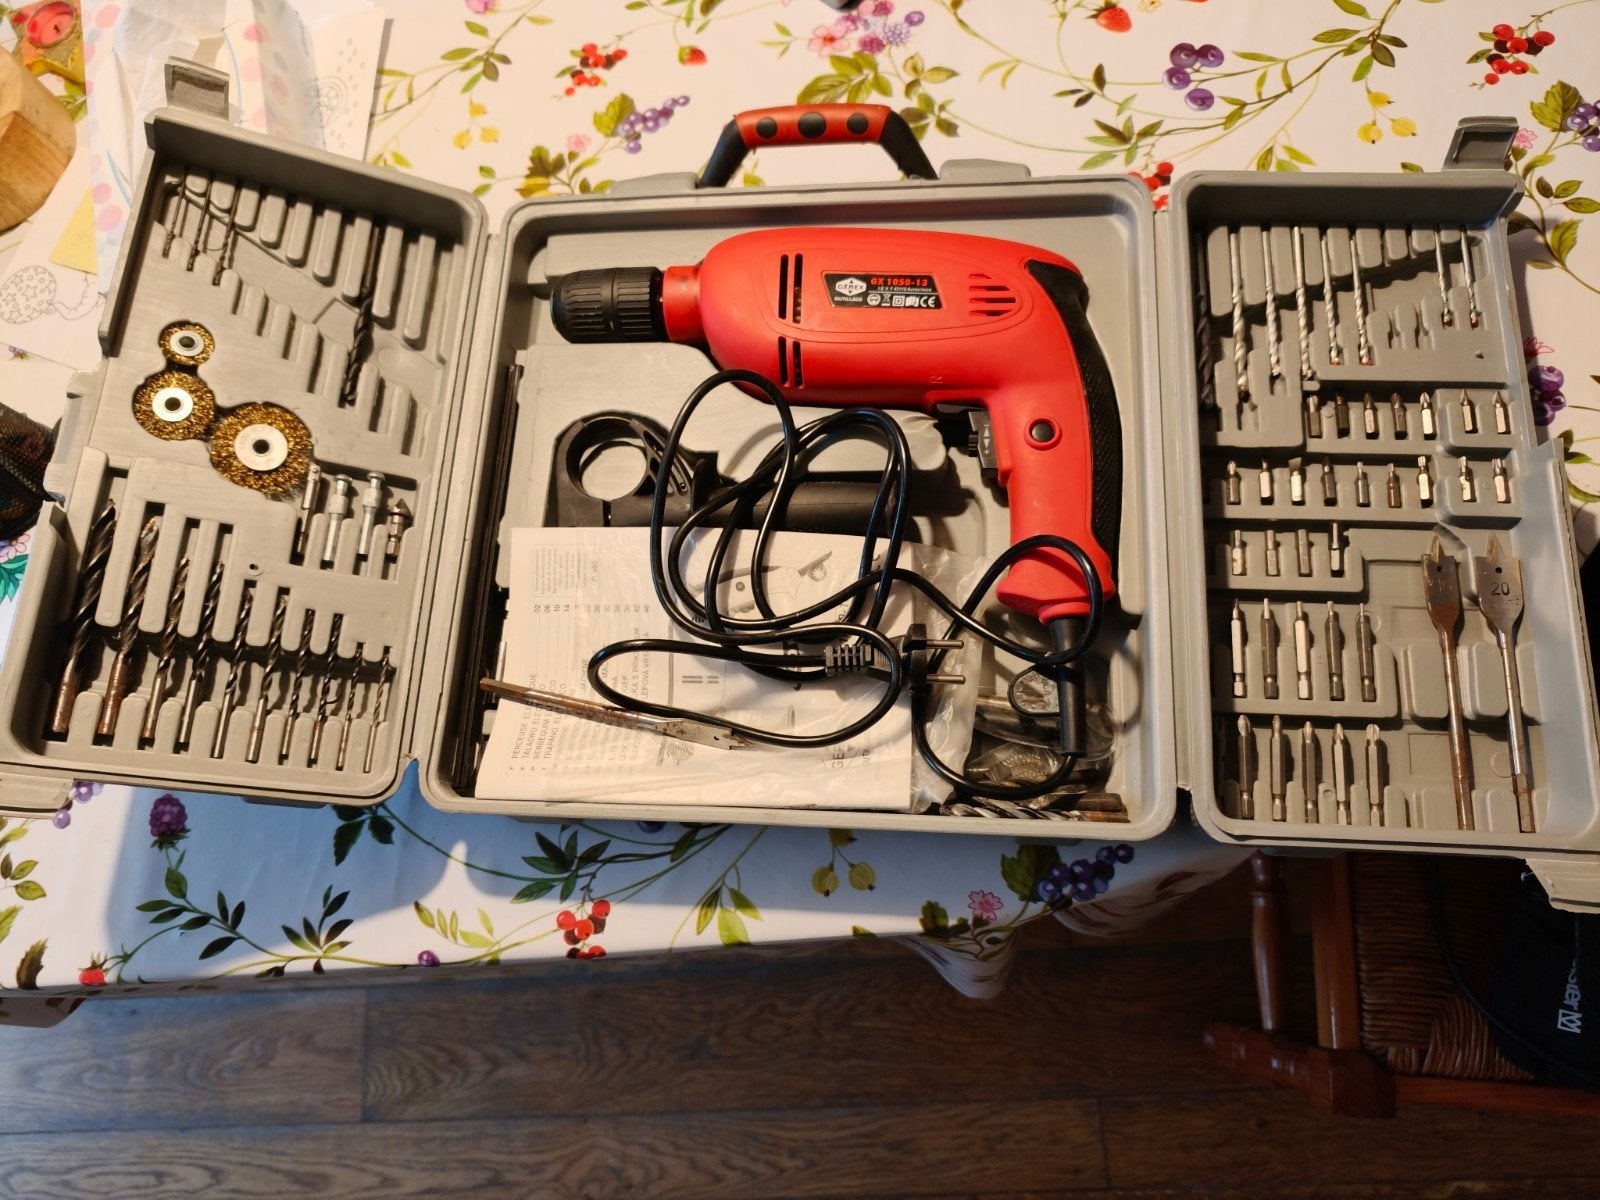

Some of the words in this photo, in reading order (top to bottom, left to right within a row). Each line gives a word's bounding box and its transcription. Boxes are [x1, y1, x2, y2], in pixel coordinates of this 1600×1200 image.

[870, 277, 884, 285] GX
[887, 278, 928, 287] 1050-13
[1491, 581, 1510, 596] 20
[511, 722, 528, 759] PERCEUSE
[534, 604, 541, 613] 02
[521, 727, 538, 759] TALADRO
[544, 604, 551, 613] 06
[532, 718, 549, 759] BERBEQUIM
[554, 604, 561, 612] 10
[543, 727, 559, 759] TRAPANO
